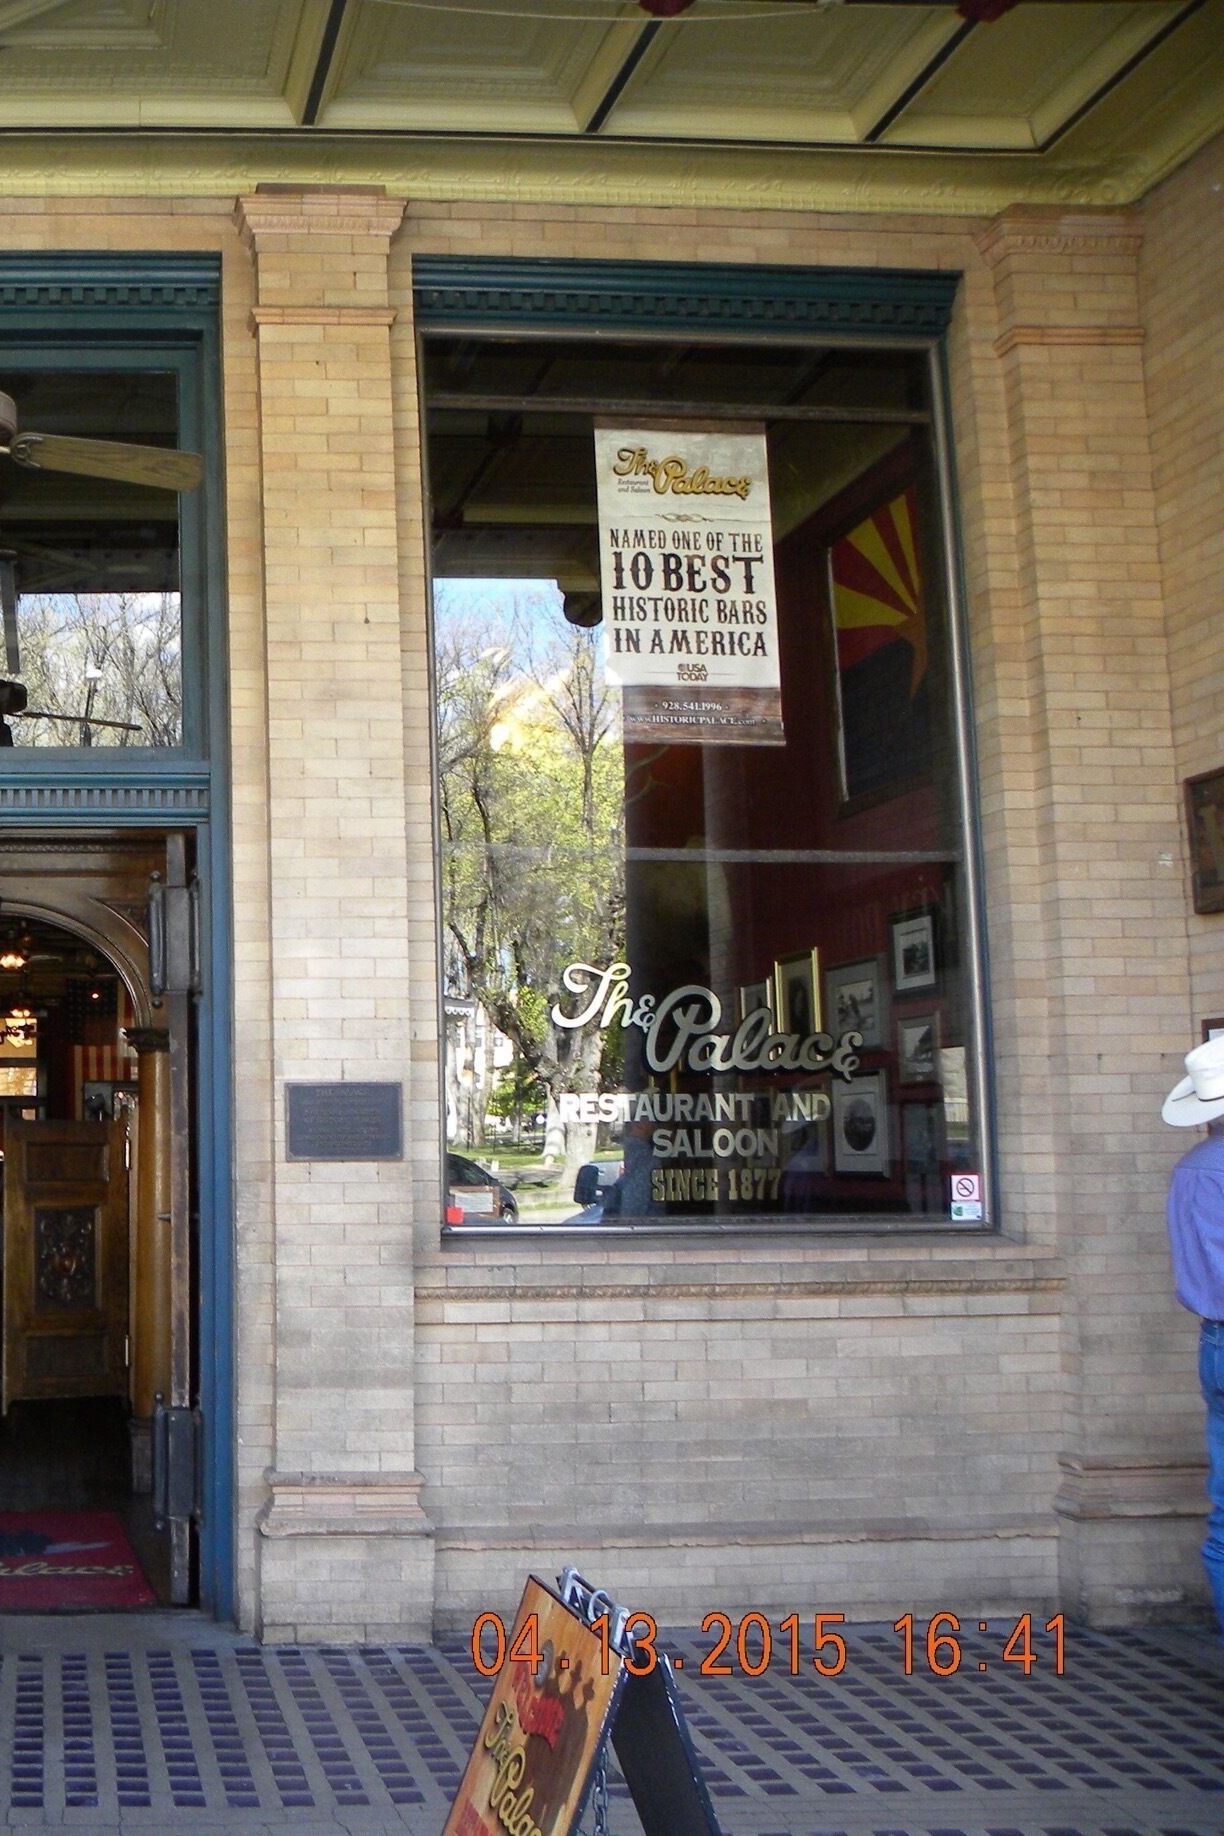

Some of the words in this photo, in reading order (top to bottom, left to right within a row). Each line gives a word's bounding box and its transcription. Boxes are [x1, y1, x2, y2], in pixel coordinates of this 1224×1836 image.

[613, 447, 660, 477] The
[653, 455, 753, 501] Palace
[610, 528, 666, 550] NAMED
[672, 530, 701, 551] ONE
[706, 532, 724, 551] OF
[729, 533, 763, 553] THE
[612, 552, 654, 590] 10
[662, 552, 764, 594] BEST
[612, 596, 709, 624] HISTORIC
[717, 599, 767, 625] BARS
[613, 628, 641, 655] IN
[649, 629, 768, 657] AMERICA
[676, 671, 709, 682] TODAY
[687, 663, 708, 673] USA
[551, 961, 657, 1032] The
[645, 983, 864, 1084] Palace
[559, 1092, 752, 1123] RESTAURANT
[770, 1092, 831, 1122] AND
[652, 1127, 780, 1159] SALOON
[650, 1168, 719, 1202] SINCE
[727, 1168, 782, 1202] 1877
